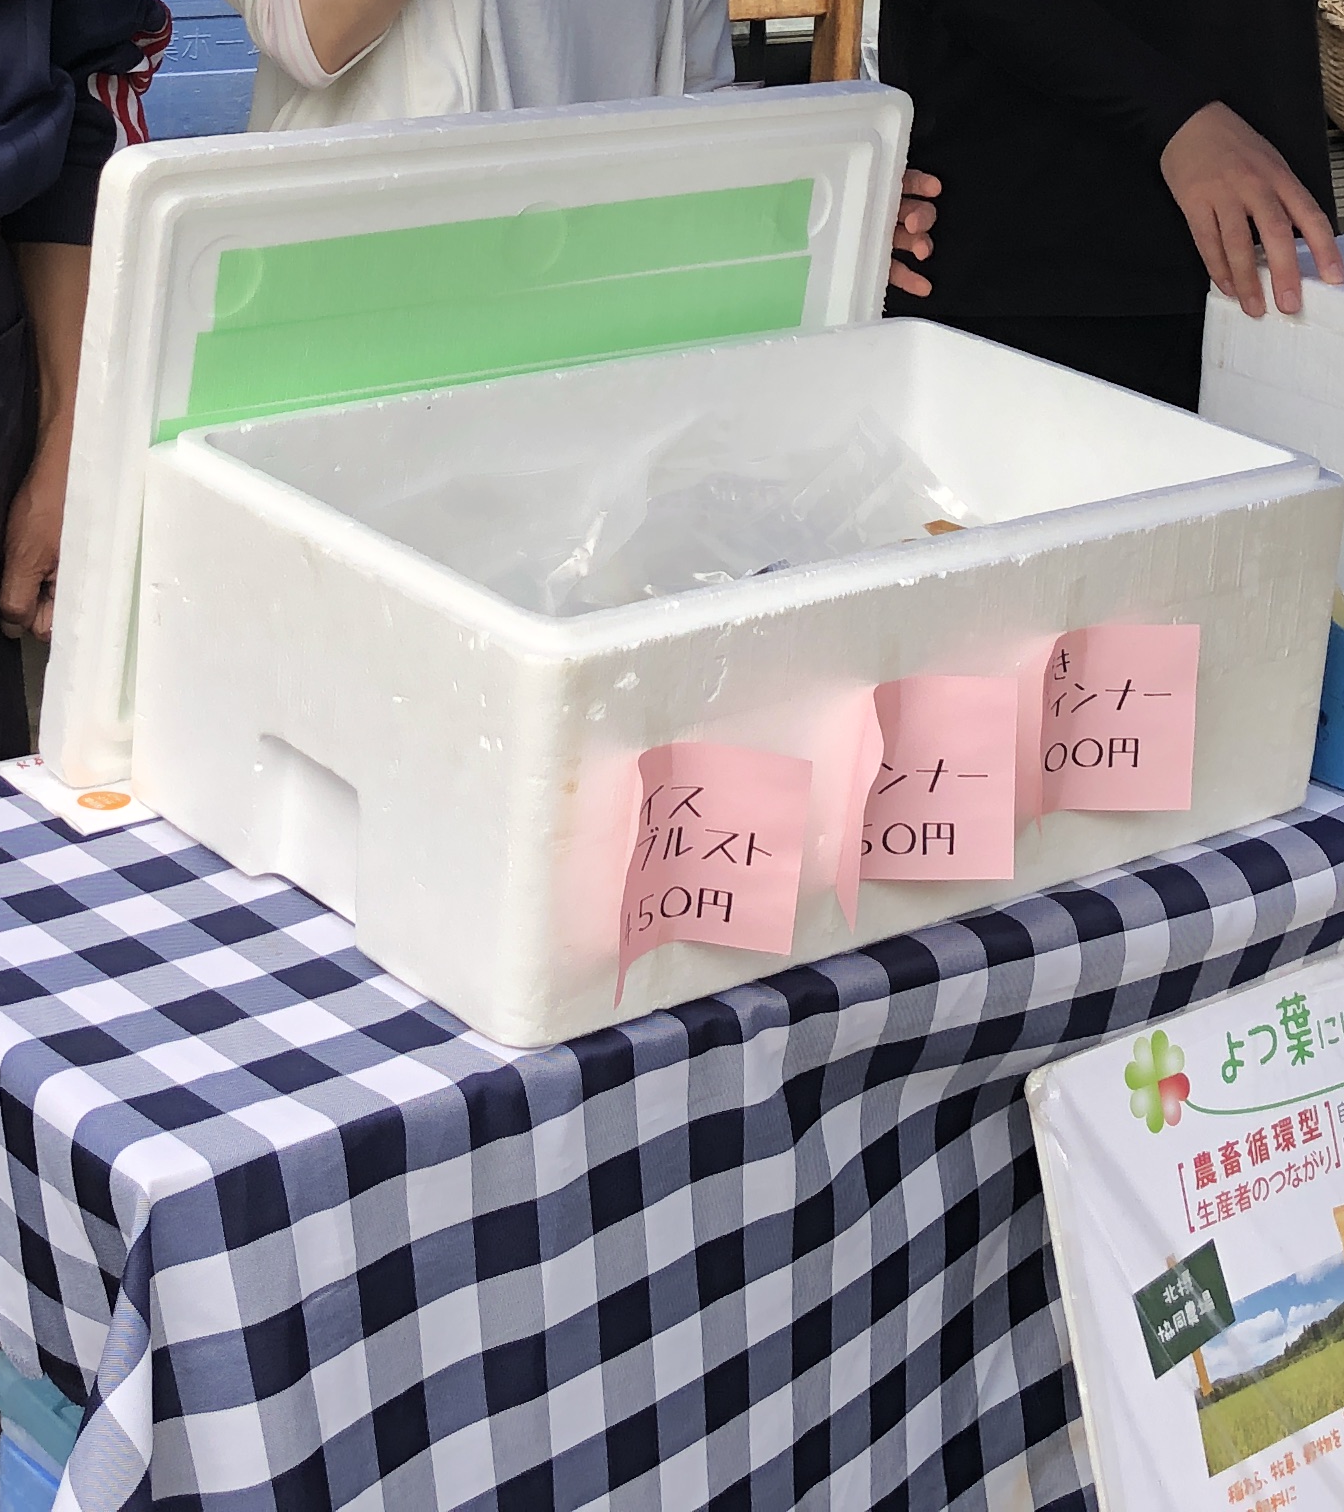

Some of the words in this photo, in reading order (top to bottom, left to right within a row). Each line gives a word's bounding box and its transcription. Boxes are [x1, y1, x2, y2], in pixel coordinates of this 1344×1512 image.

[1046, 678, 1172, 718] インナー
[1044, 737, 1140, 772] 00円
[639, 784, 706, 827] イス
[637, 825, 774, 872] ブルスト
[1192, 1104, 1323, 1190] 農畜循環型
[1196, 1146, 1333, 1231] 生産者のつながり
[1157, 1289, 1216, 1343] 協同農場
